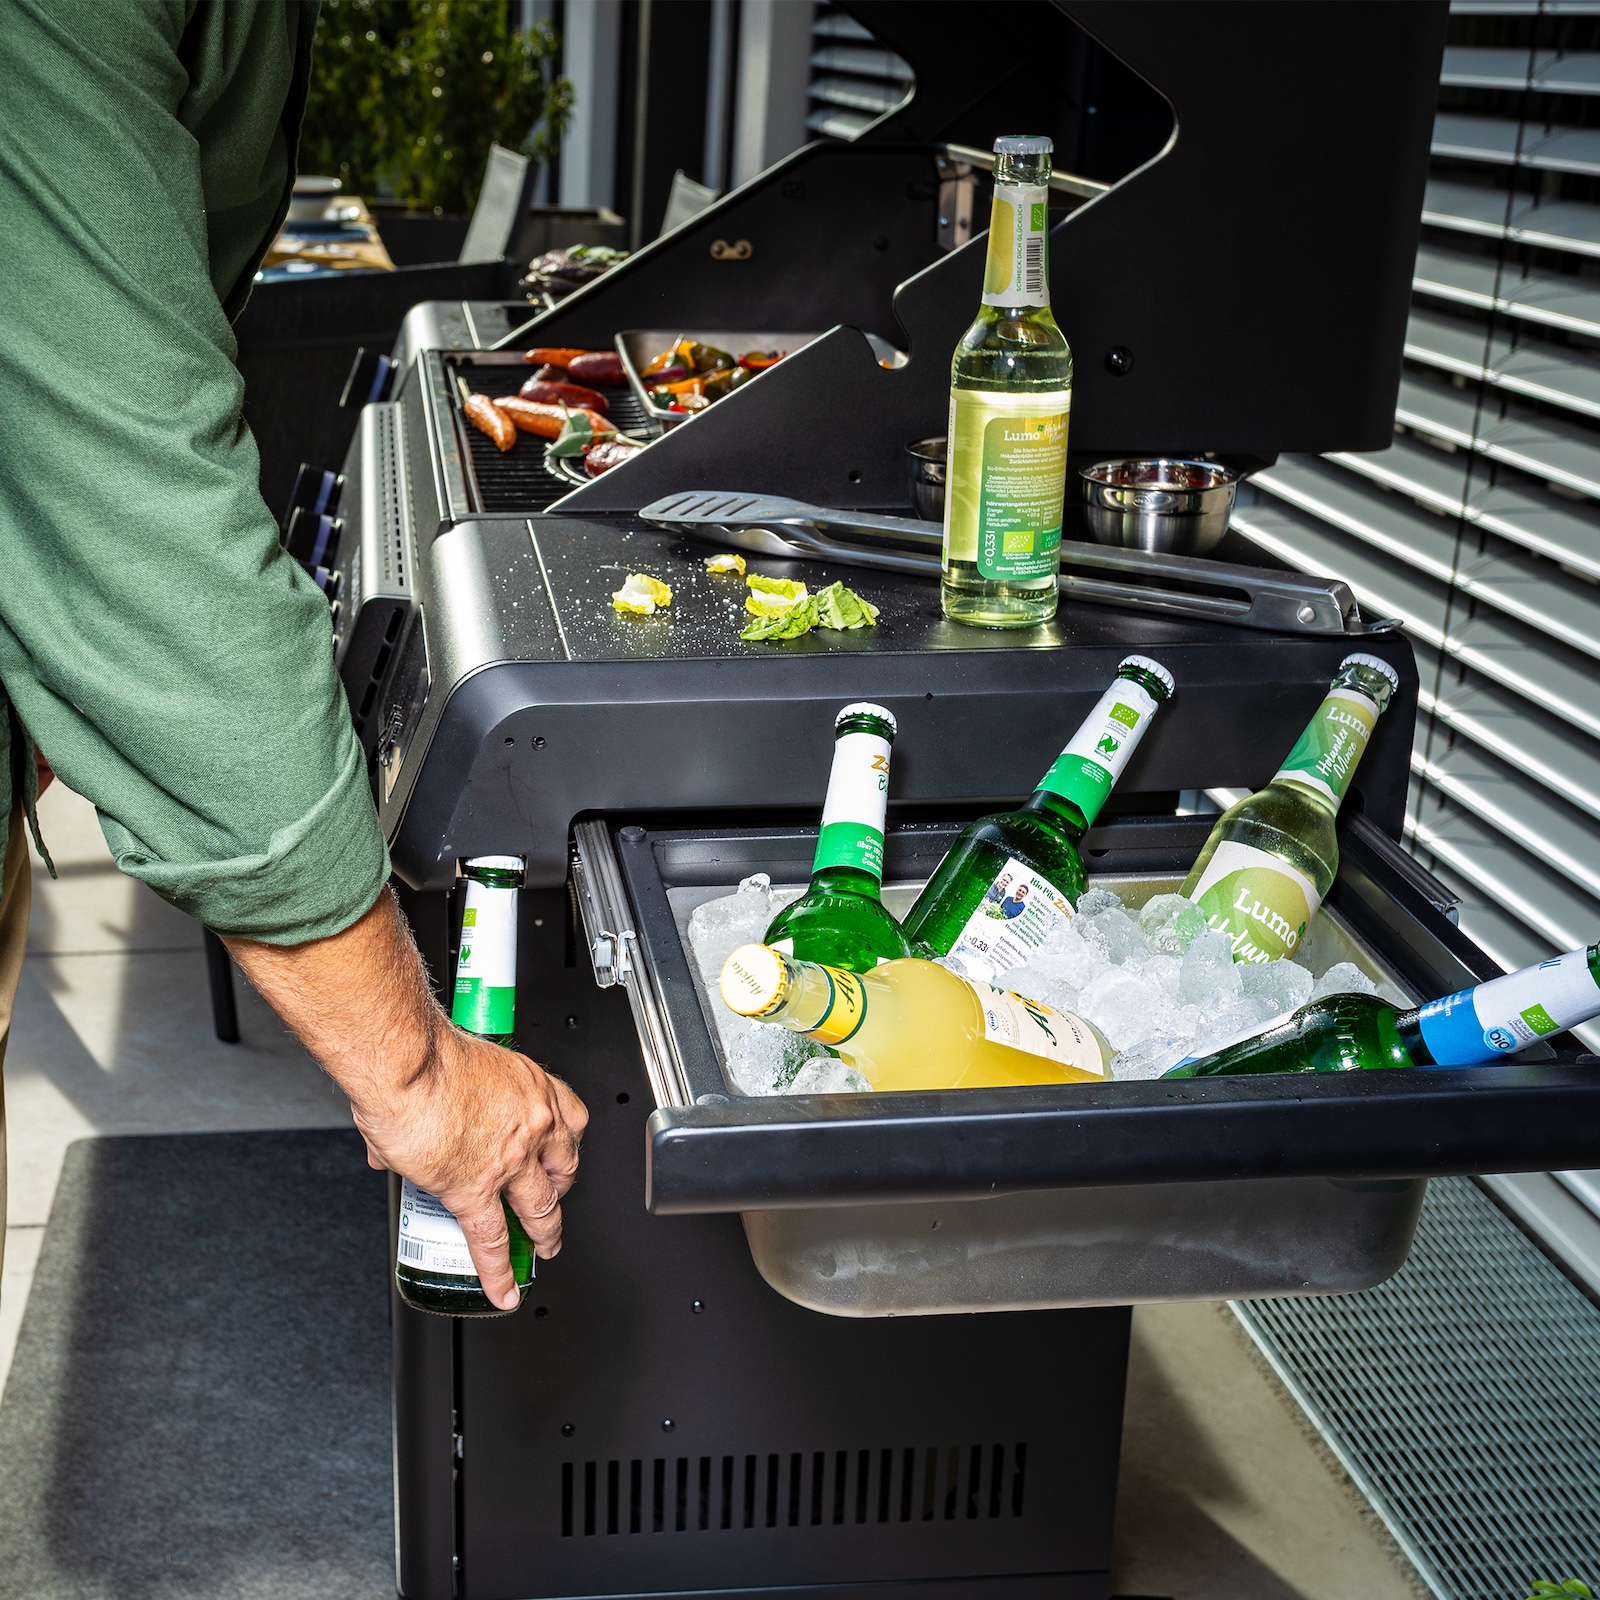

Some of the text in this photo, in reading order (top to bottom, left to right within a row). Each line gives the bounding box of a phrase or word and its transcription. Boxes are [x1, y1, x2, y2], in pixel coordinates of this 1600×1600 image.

[1004, 430, 1040, 442] Lumo
[1327, 706, 1371, 742] Lumo
[1316, 727, 1348, 776] Holunder
[1333, 742, 1356, 779] Minze
[1030, 877, 1042, 890] Bio
[1042, 887, 1055, 901] Pils
[1233, 887, 1297, 948] Lumo
[1489, 1029, 1510, 1050] bio
